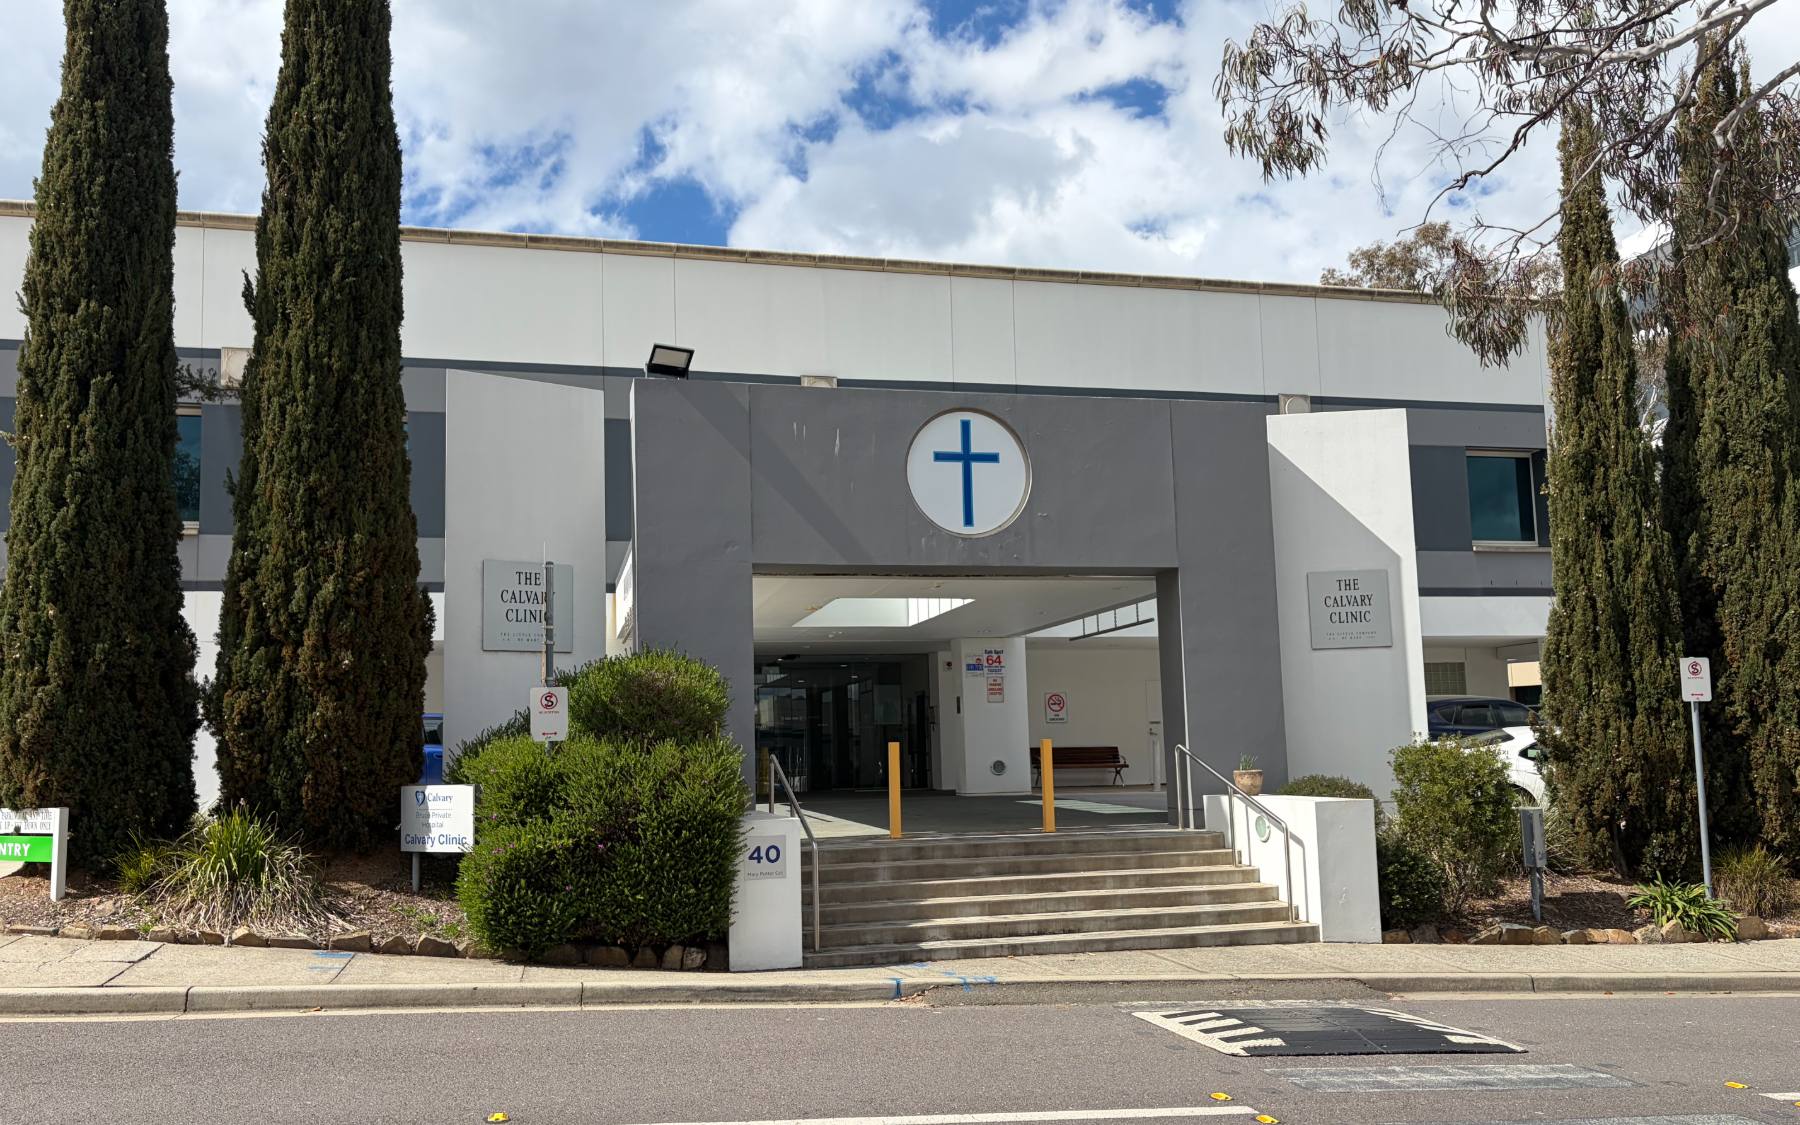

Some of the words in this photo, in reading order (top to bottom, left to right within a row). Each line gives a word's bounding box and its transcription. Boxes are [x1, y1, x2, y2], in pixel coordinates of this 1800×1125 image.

[515, 571, 542, 586] THE
[1336, 578, 1360, 591] THE
[500, 589, 556, 605] CALVAR
[1324, 593, 1373, 608] CALVARY
[505, 608, 547, 624] CLINI
[1329, 610, 1372, 624] CLINIC
[986, 655, 1002, 666] 64
[427, 793, 453, 803] Calvary
[405, 833, 436, 847] Calvary
[438, 834, 467, 845] Clinic
[748, 844, 781, 864] 40
